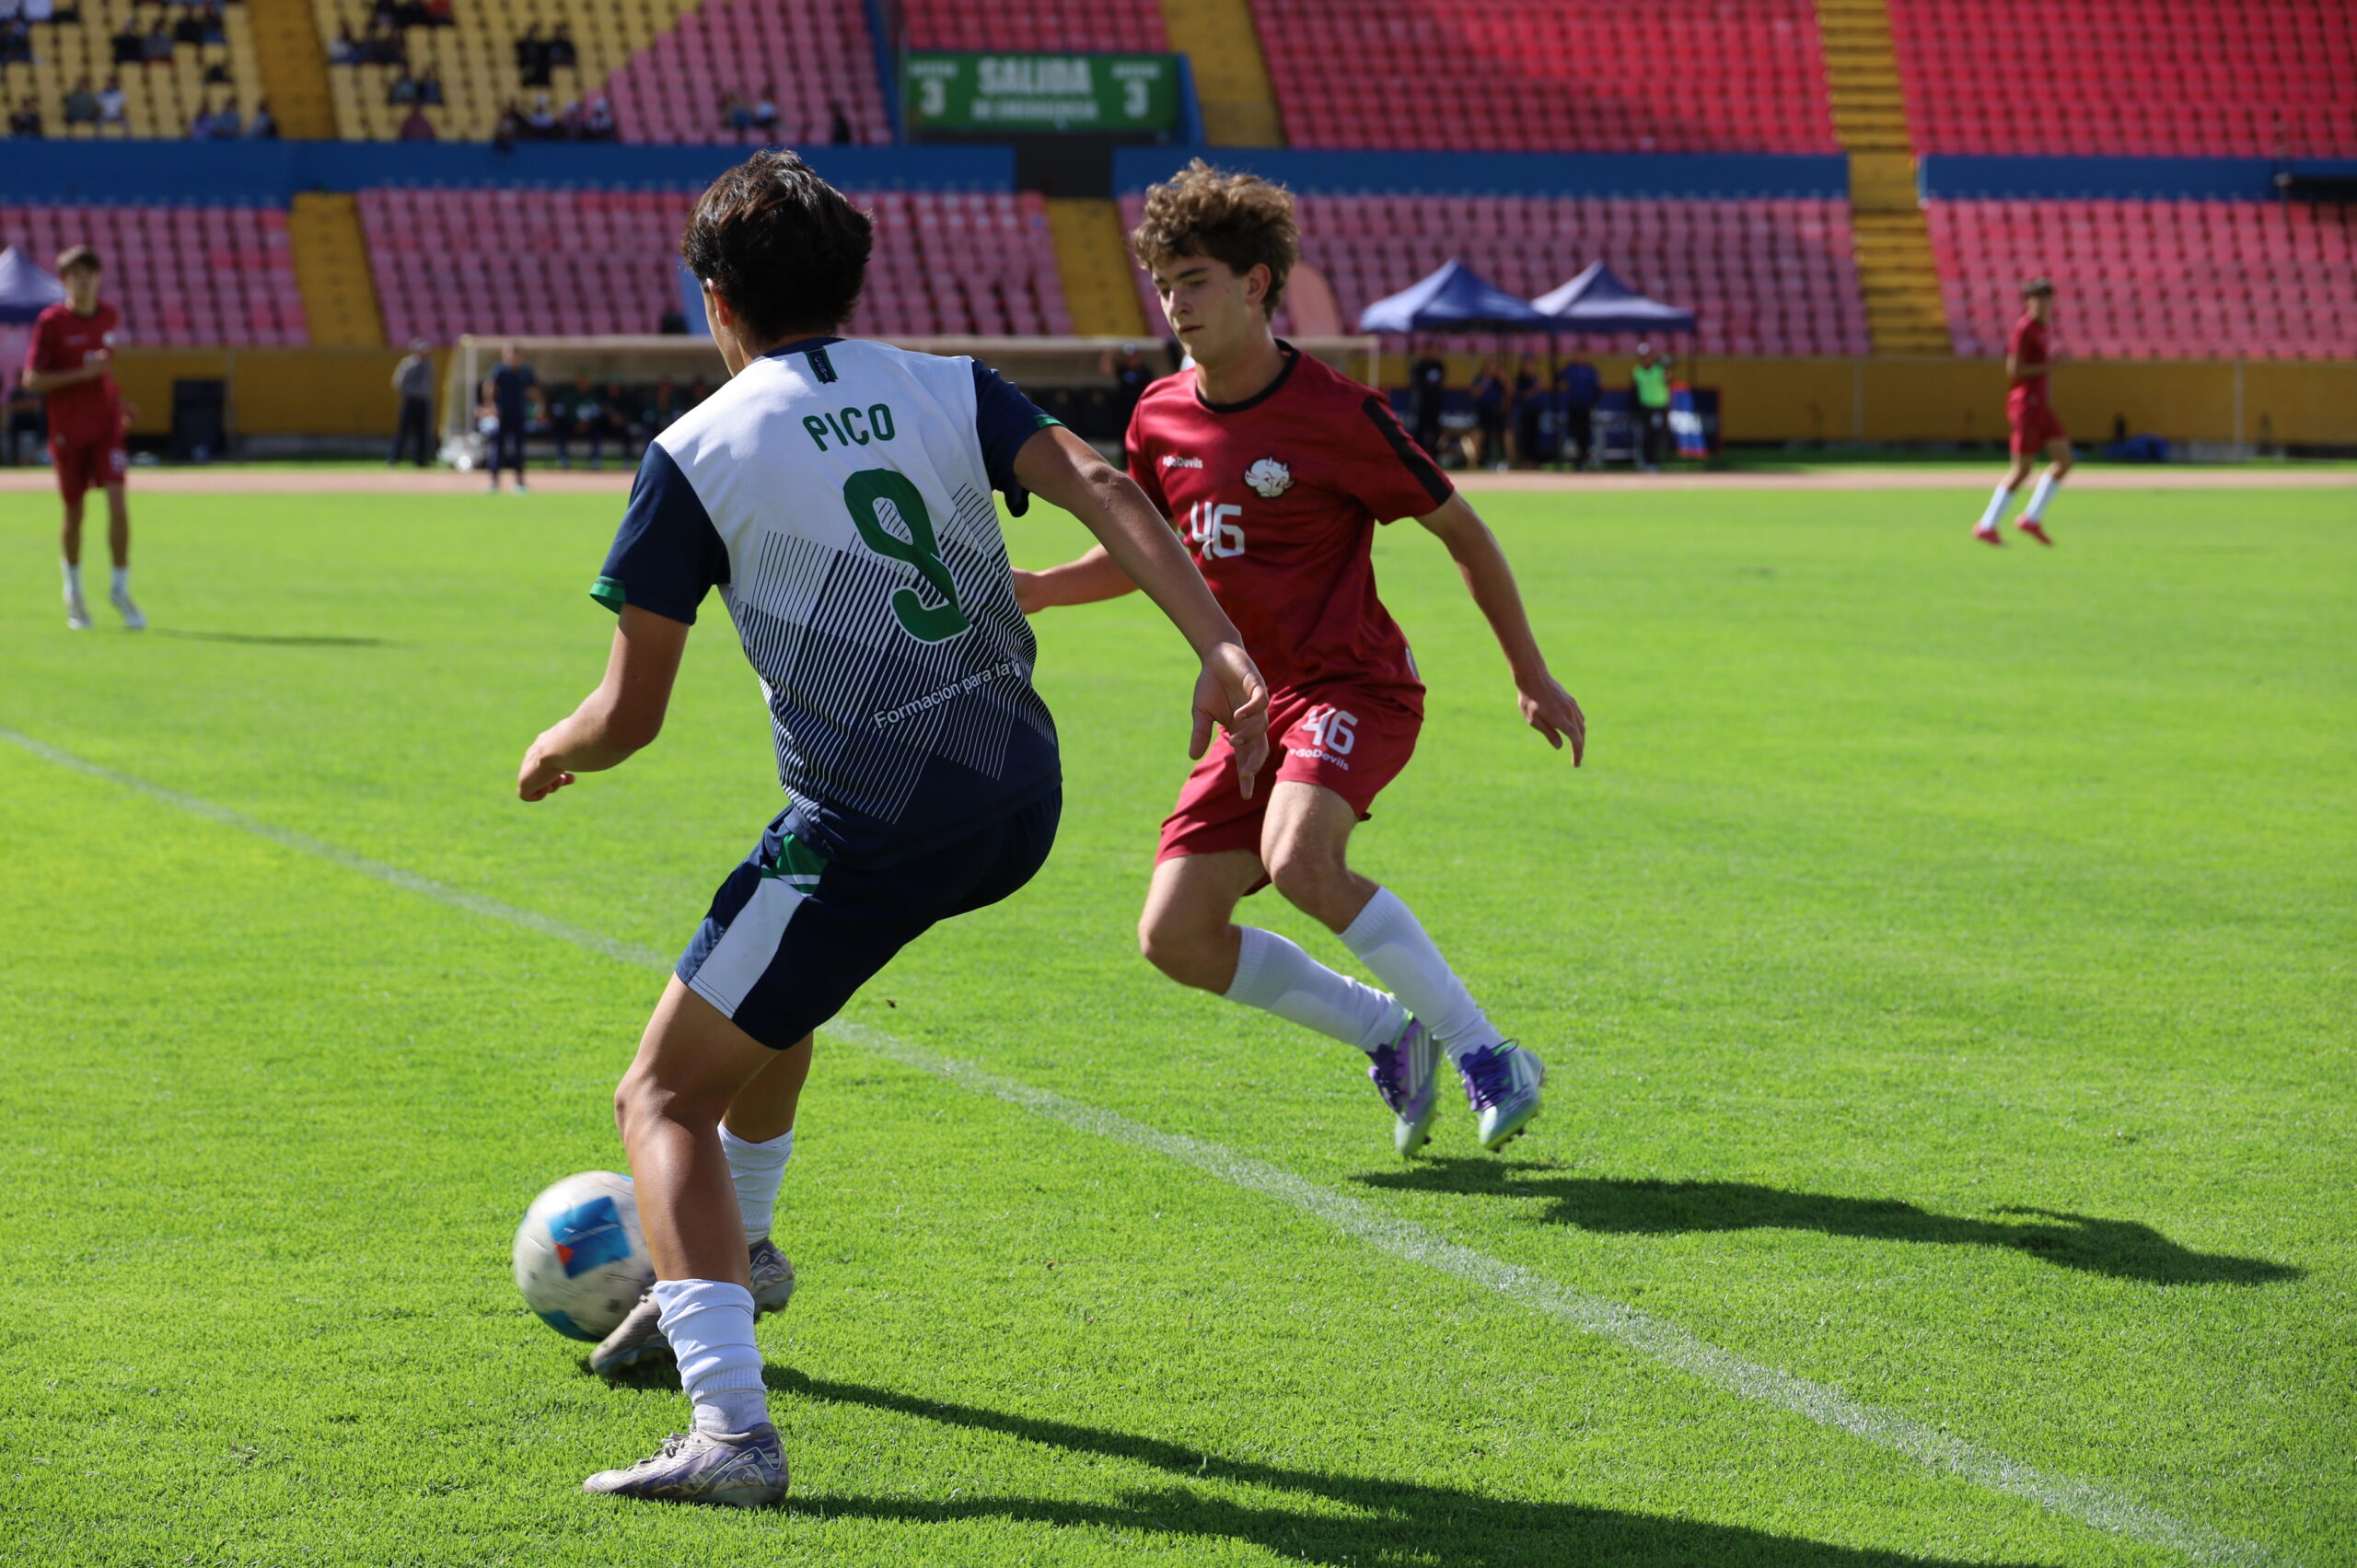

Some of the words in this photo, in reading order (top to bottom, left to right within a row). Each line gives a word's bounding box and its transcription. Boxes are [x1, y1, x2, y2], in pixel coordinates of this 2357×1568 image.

[922, 78, 946, 117] 3
[978, 57, 1093, 95] SALIDA
[1123, 78, 1148, 118] 3
[802, 403, 895, 452] PICO
[1190, 501, 1245, 561] 46
[843, 468, 972, 645] 9
[874, 681, 961, 729] Formación
[962, 668, 993, 695] para
[995, 662, 1010, 678] la
[1301, 707, 1359, 755] 46
